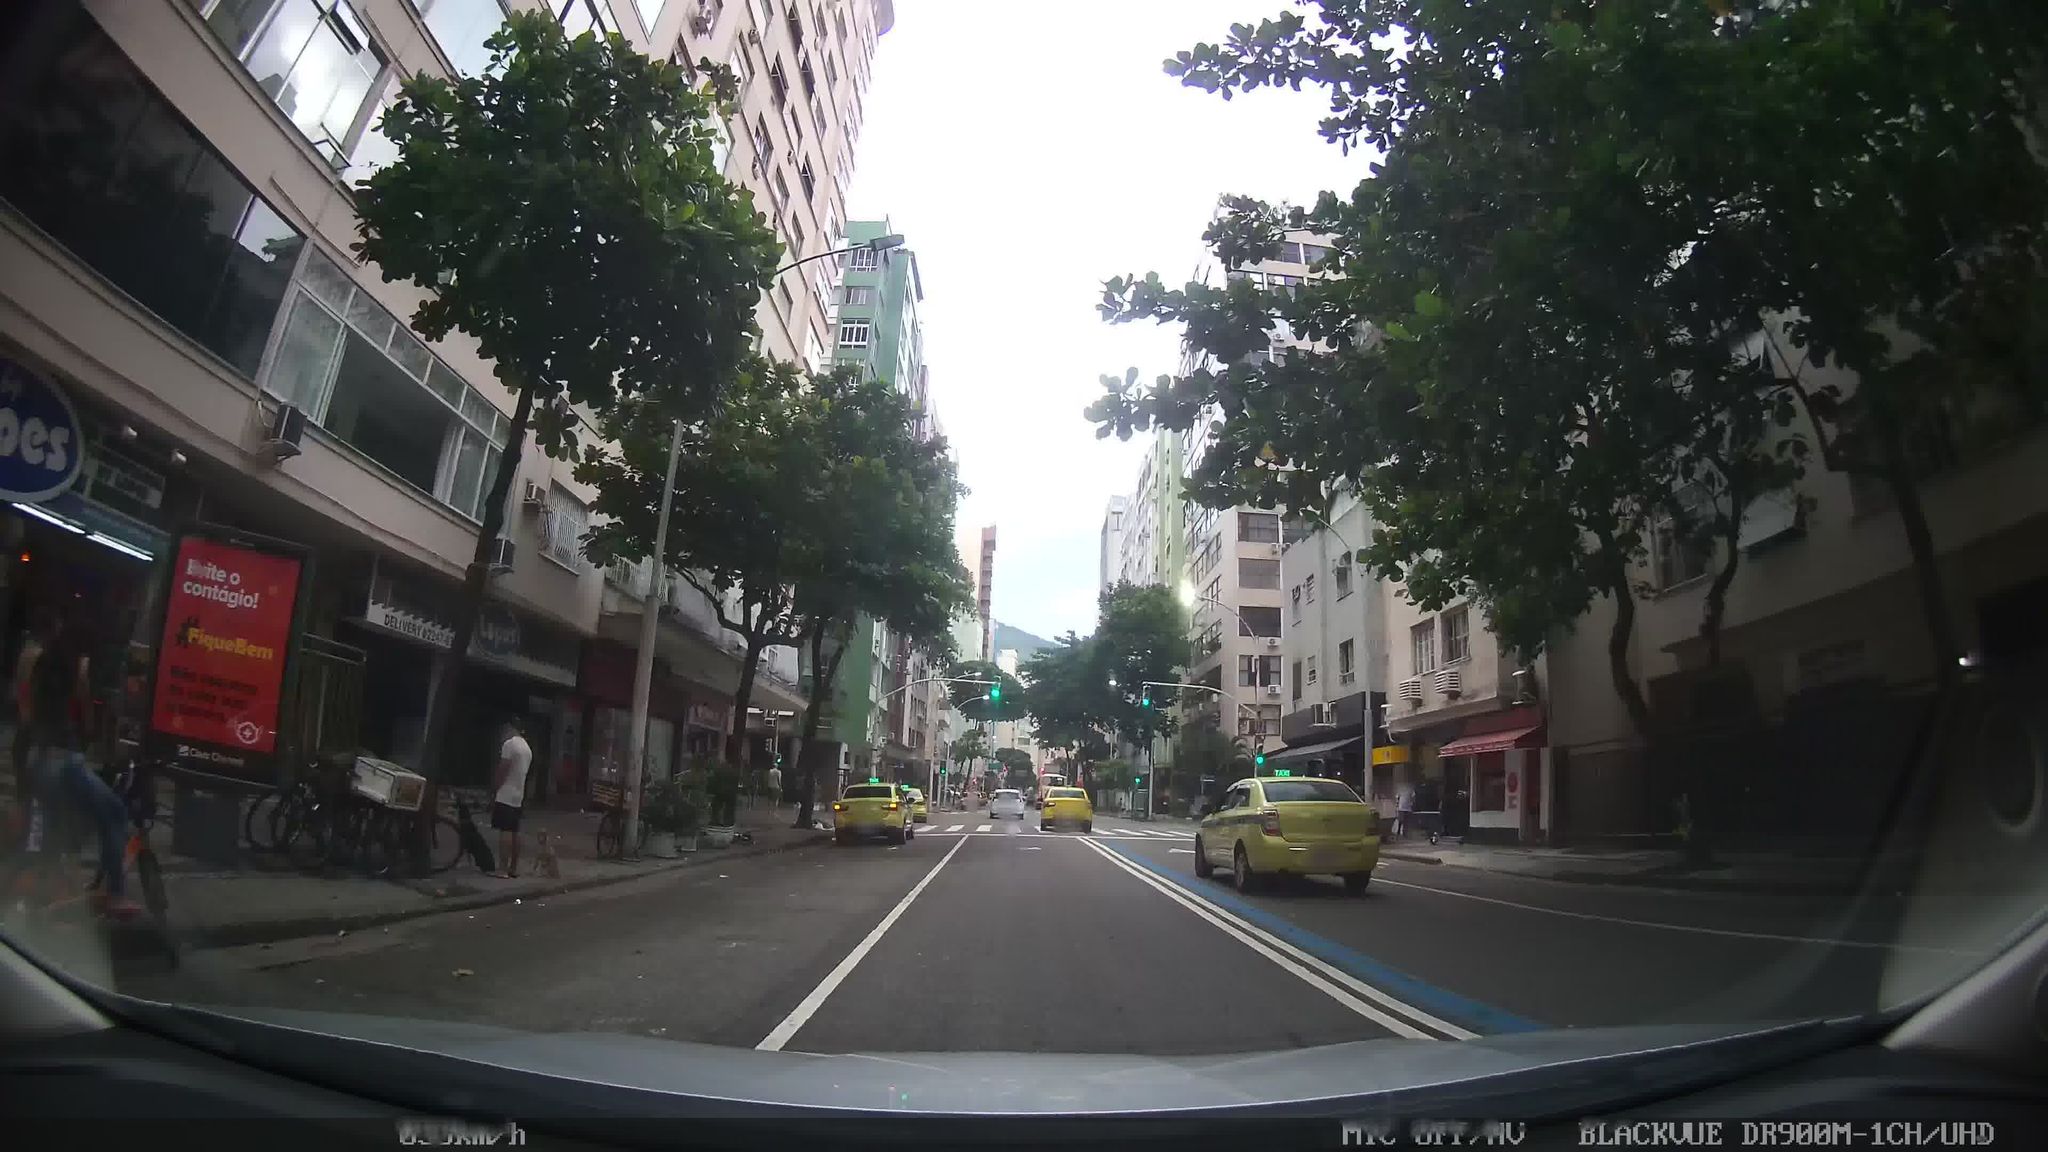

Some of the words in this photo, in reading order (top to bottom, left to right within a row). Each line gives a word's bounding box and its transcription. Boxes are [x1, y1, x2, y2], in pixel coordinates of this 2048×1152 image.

[229, 572, 241, 586] o
[183, 581, 259, 609] contágio!
[384, 614, 422, 637] DELIVERY
